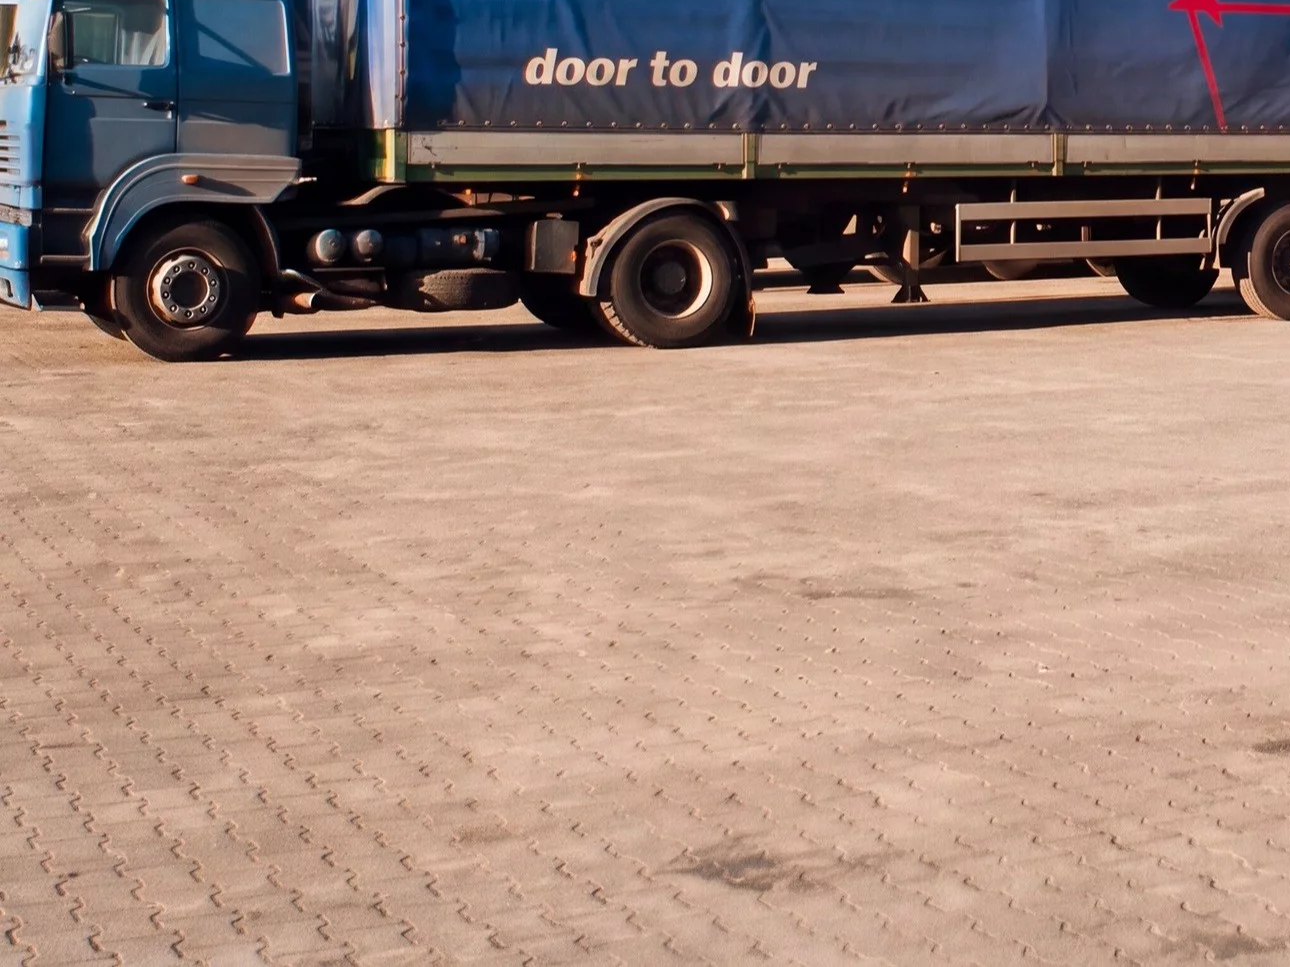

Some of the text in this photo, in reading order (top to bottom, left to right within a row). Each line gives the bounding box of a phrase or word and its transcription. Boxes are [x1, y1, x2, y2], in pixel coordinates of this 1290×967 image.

[525, 48, 818, 89] door to door
